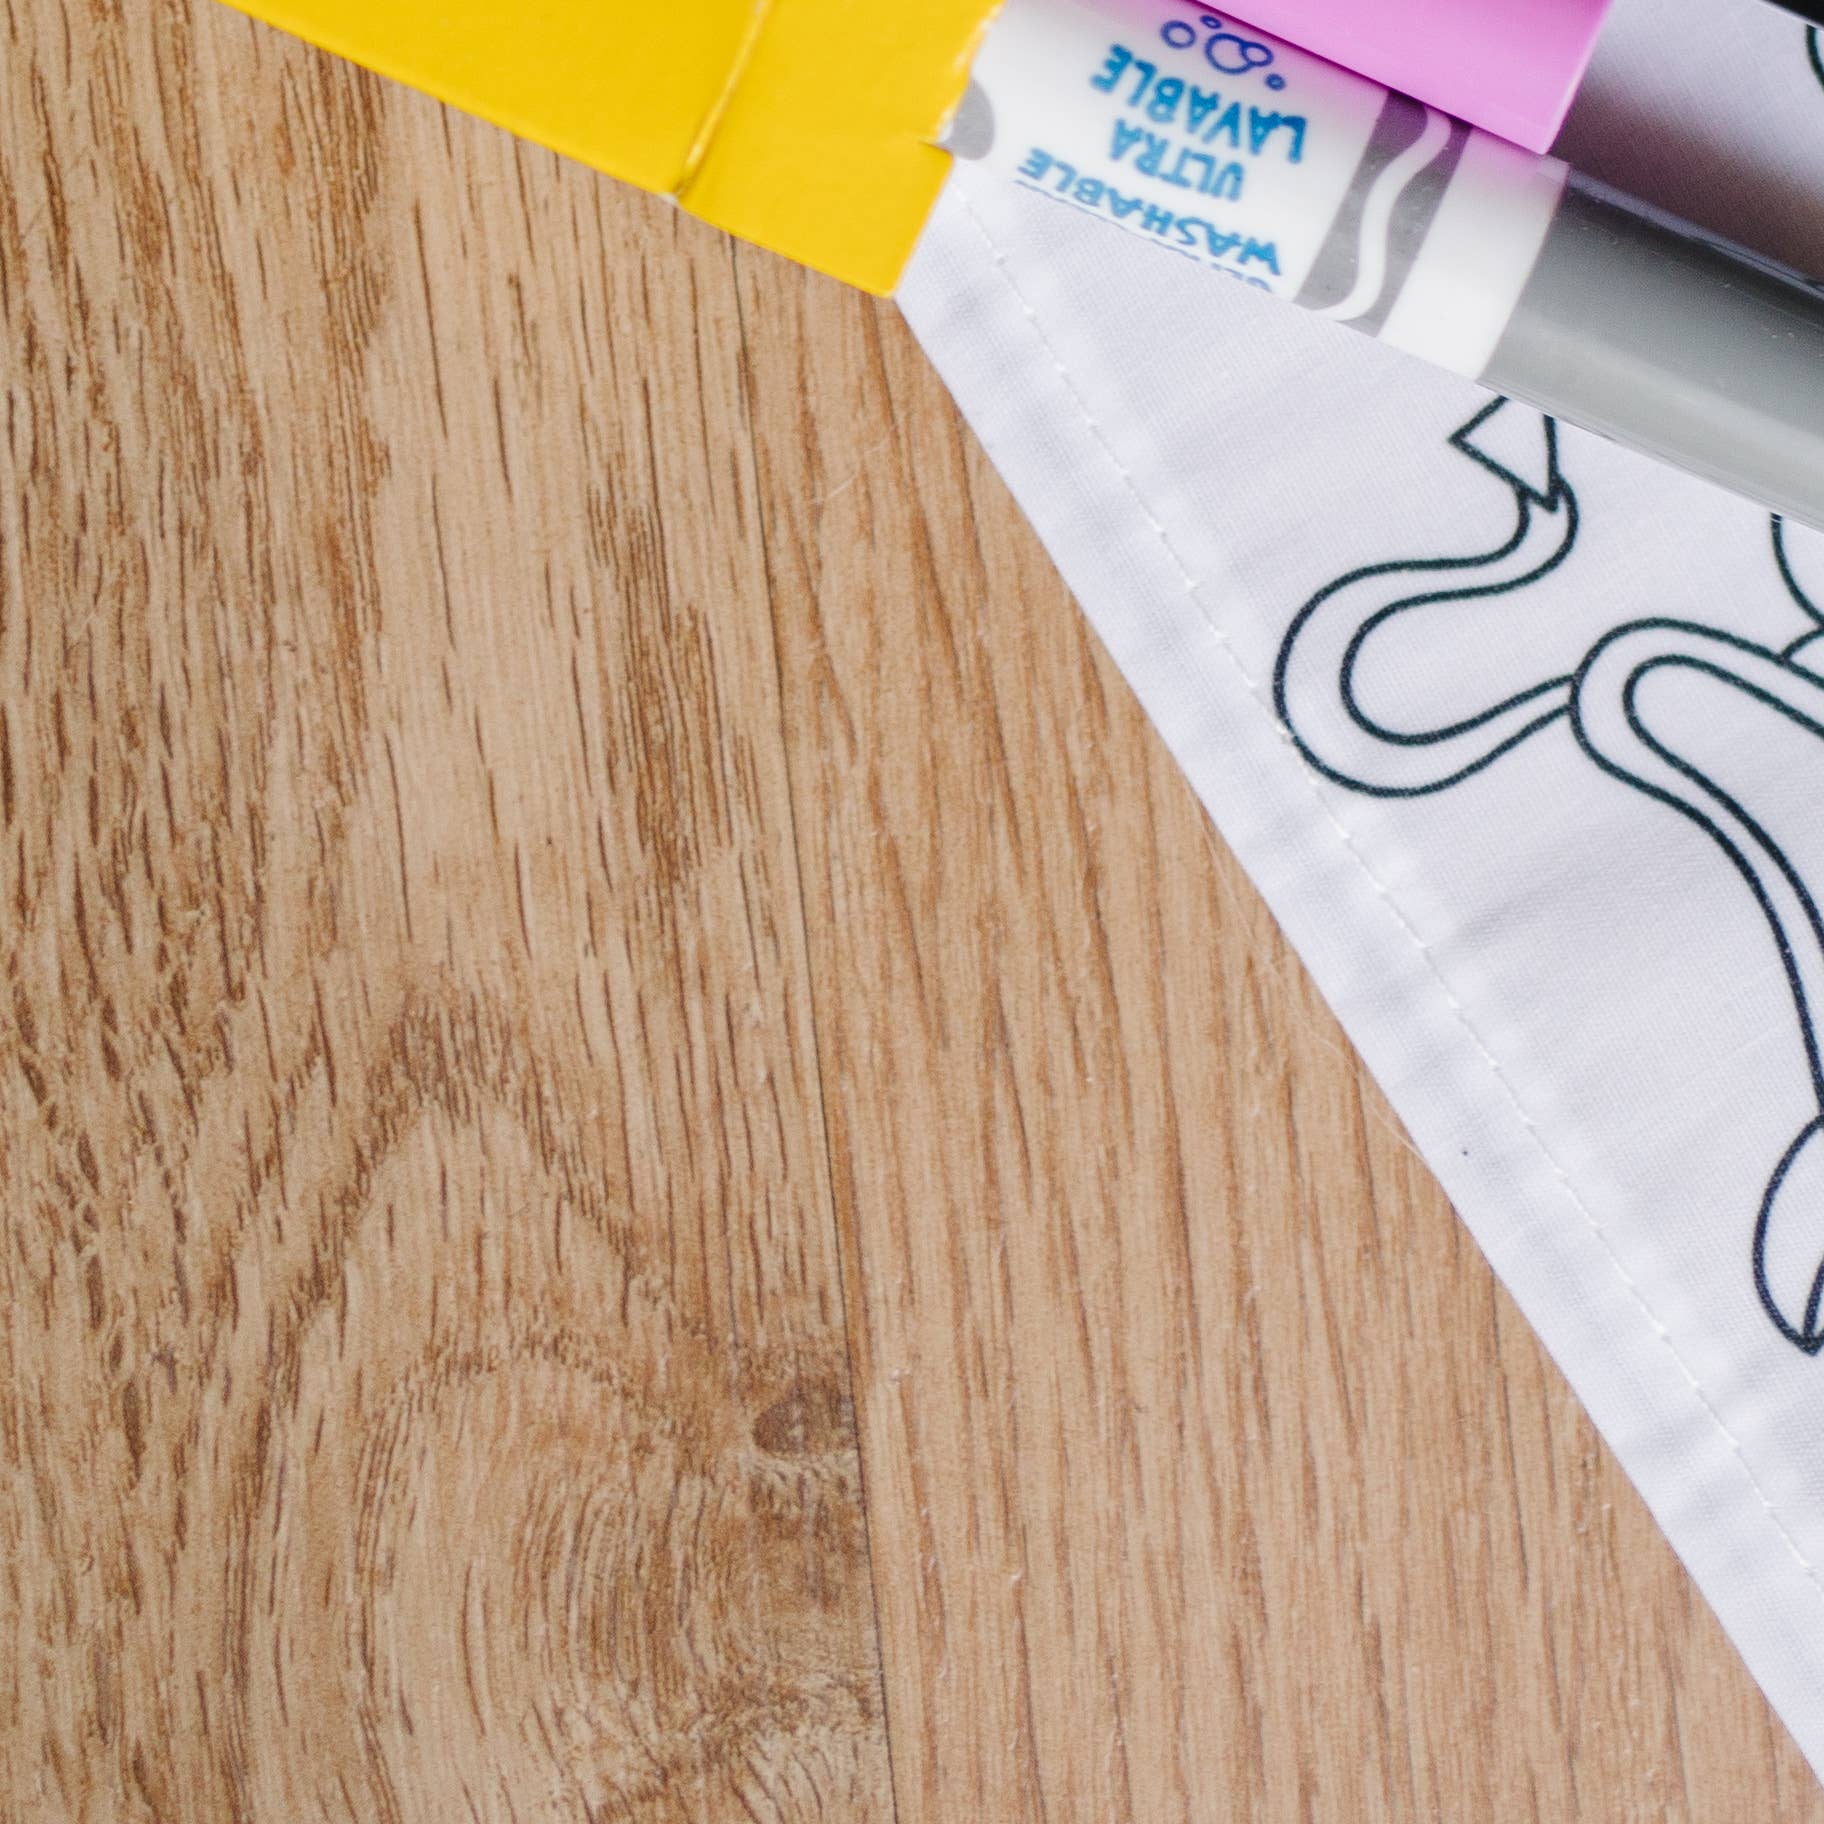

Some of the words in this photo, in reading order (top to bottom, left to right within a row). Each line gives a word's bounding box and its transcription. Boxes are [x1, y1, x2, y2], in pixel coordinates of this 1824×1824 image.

[1090, 42, 1309, 165] LAVABLE
[1110, 118, 1247, 202] ULTRA
[1015, 145, 1283, 277] WASHABLE
